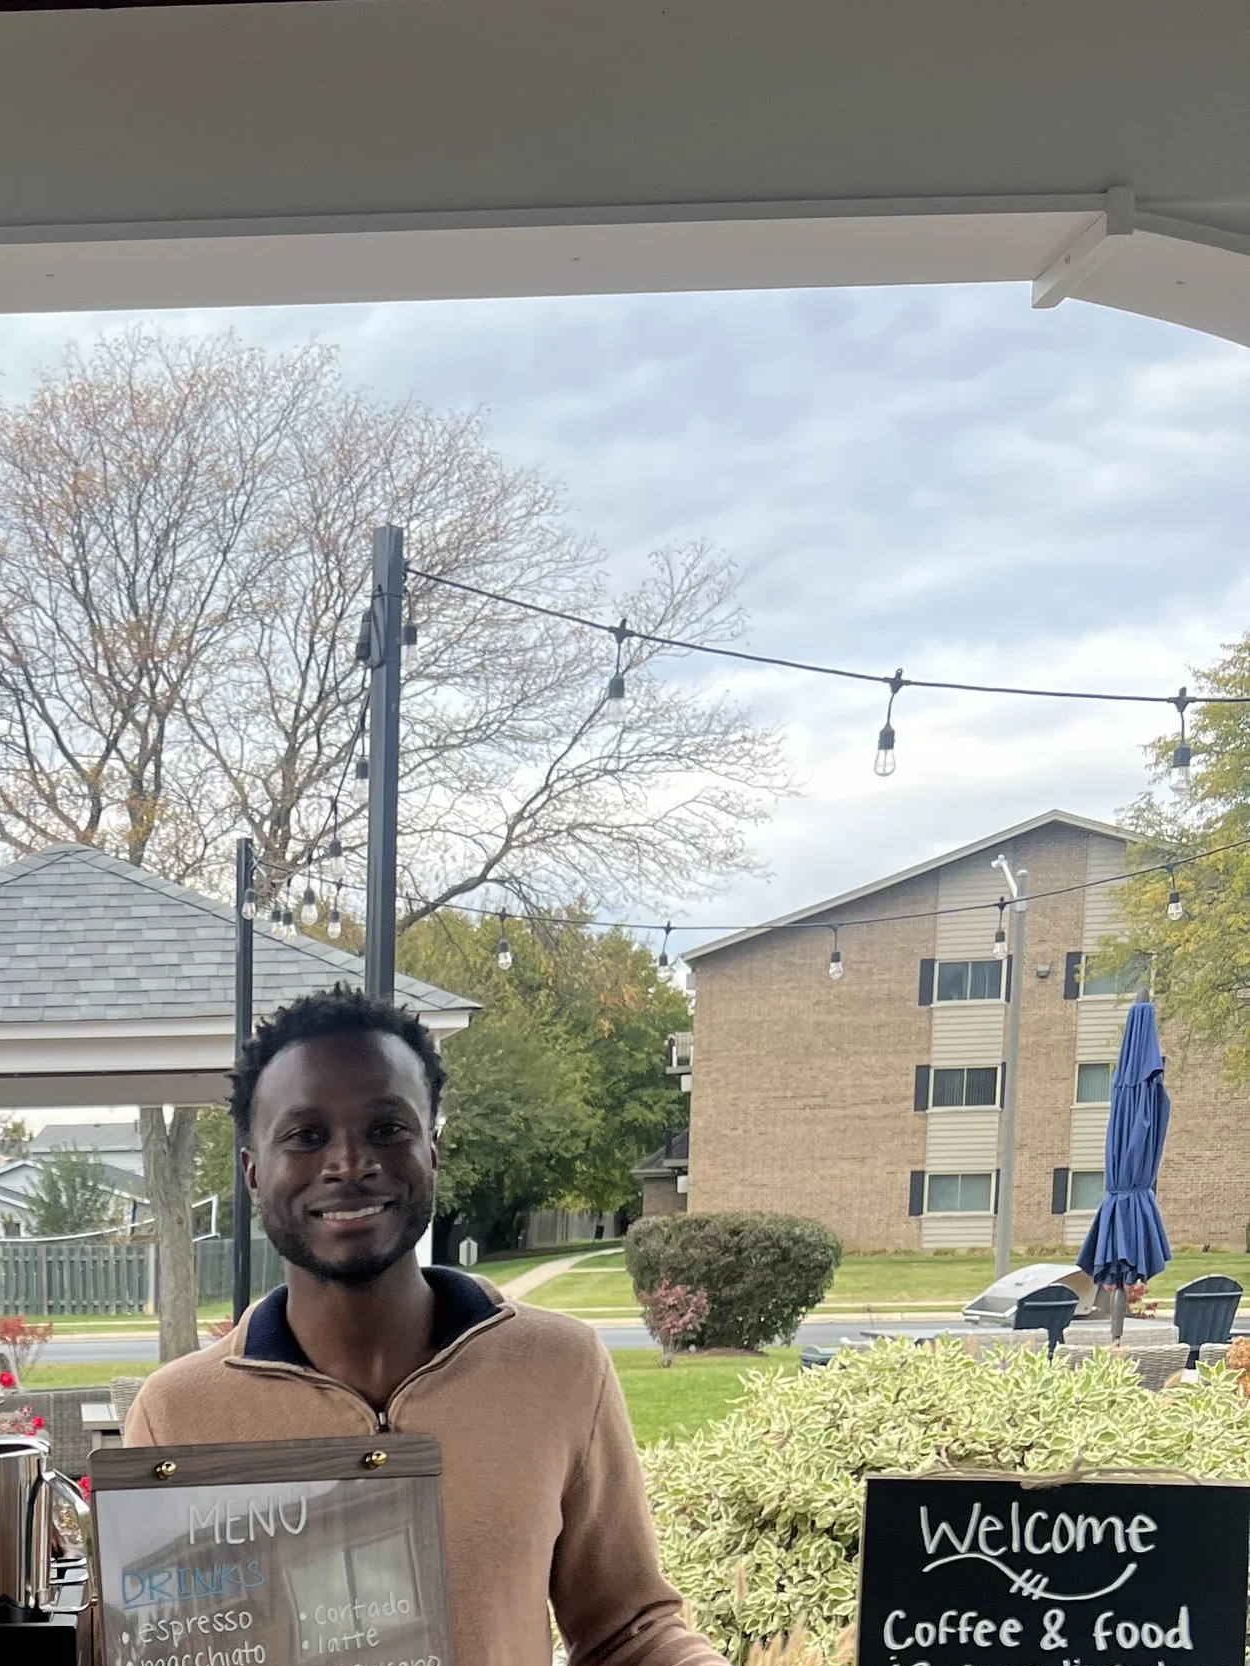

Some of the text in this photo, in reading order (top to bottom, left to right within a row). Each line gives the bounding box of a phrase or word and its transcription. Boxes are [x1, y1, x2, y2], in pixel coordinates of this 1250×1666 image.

[189, 1496, 308, 1545] MENU
[920, 1501, 1157, 1555] Welcome
[121, 1560, 267, 1604] DRINKS
[138, 1610, 253, 1647] espresso
[318, 1627, 379, 1654] latte
[883, 1604, 1194, 1651] Coffee & food
